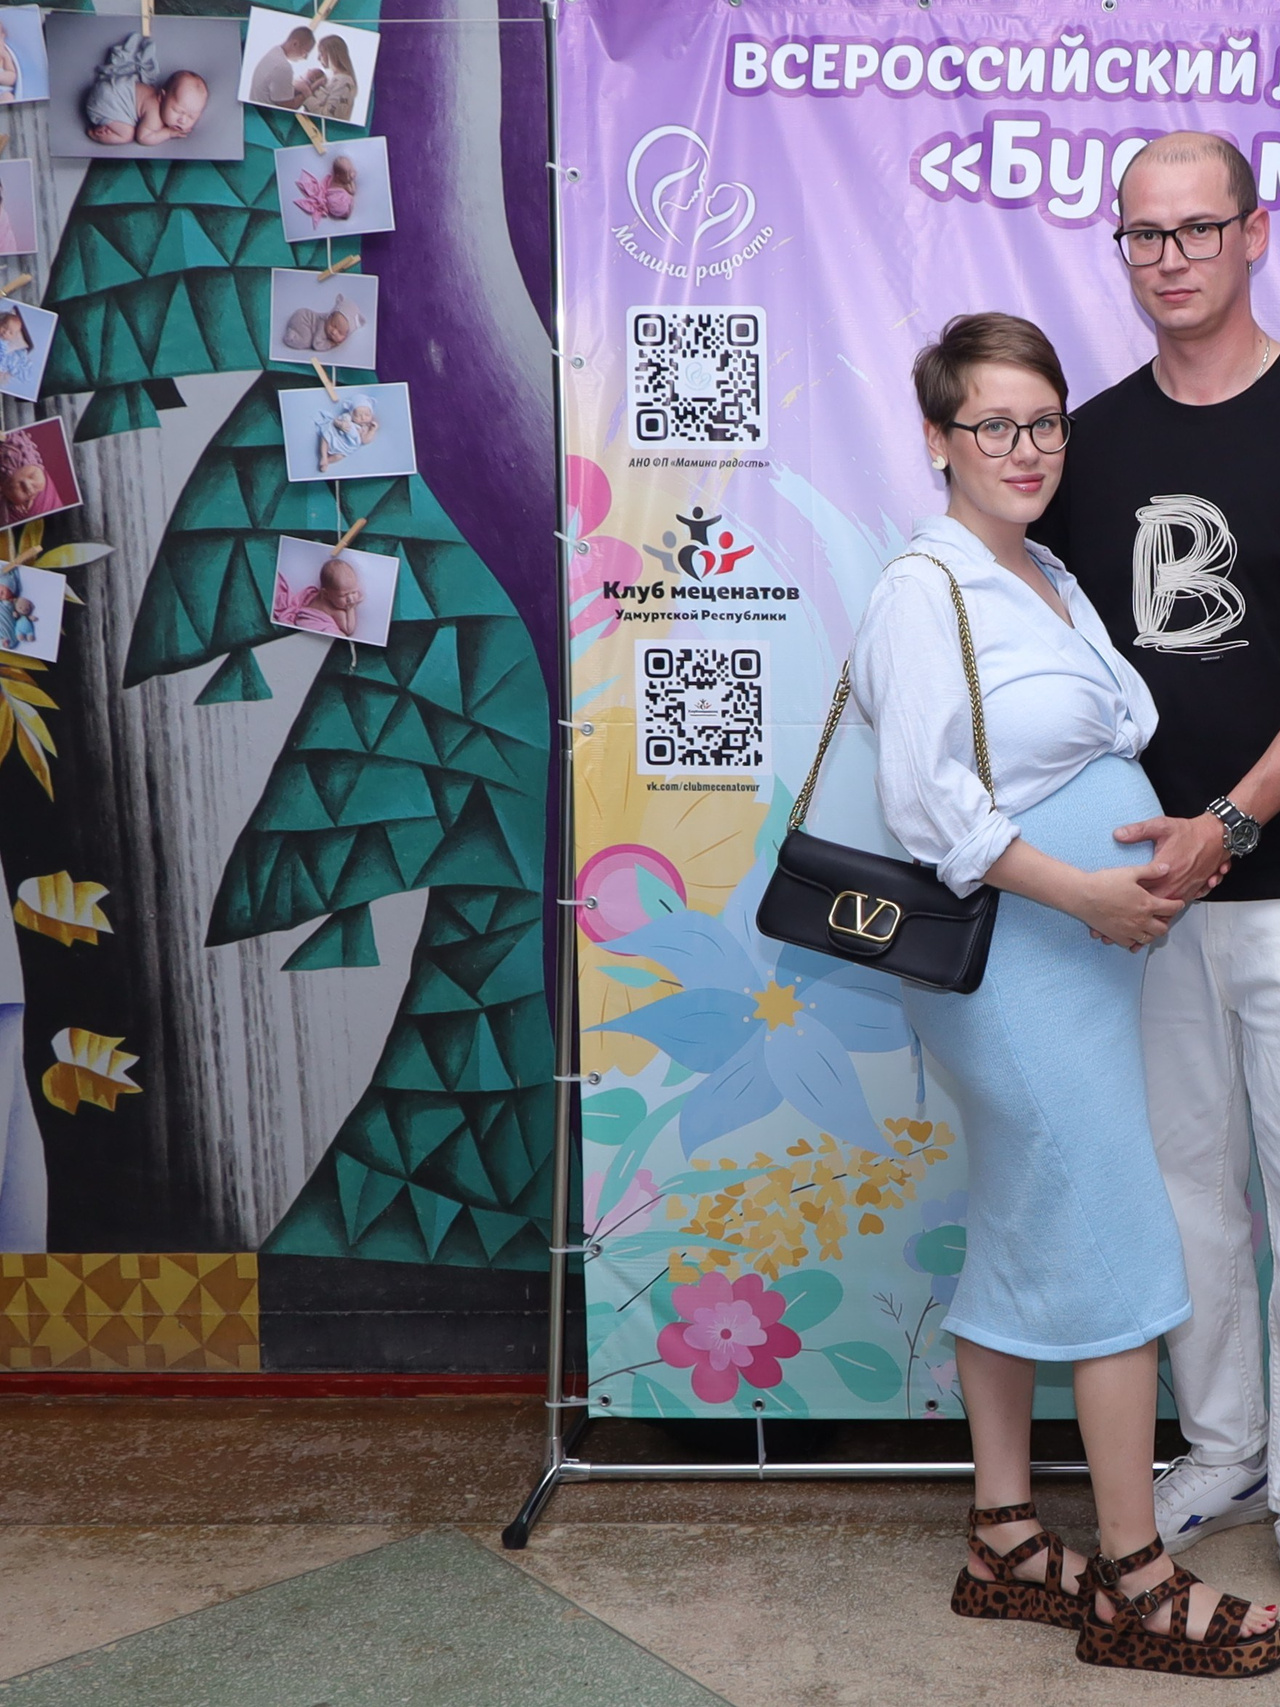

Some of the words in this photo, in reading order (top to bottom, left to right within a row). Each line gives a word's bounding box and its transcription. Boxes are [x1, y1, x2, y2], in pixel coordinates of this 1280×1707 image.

[733, 34, 1257, 96] ВСЕРОССИЙСКИЙ
[611, 225, 688, 279] Мамина
[696, 225, 773, 287] радость
[628, 457, 651, 468] АНО
[670, 457, 717, 468] «Мамина
[719, 457, 770, 469] радость»
[1132, 493, 1249, 655] B
[603, 581, 665, 604] Клуб
[671, 585, 800, 602] меценатов
[615, 609, 699, 624] Удмуртской
[701, 609, 787, 624] Республики
[646, 781, 760, 793] vk.com/clubmecenatovur
